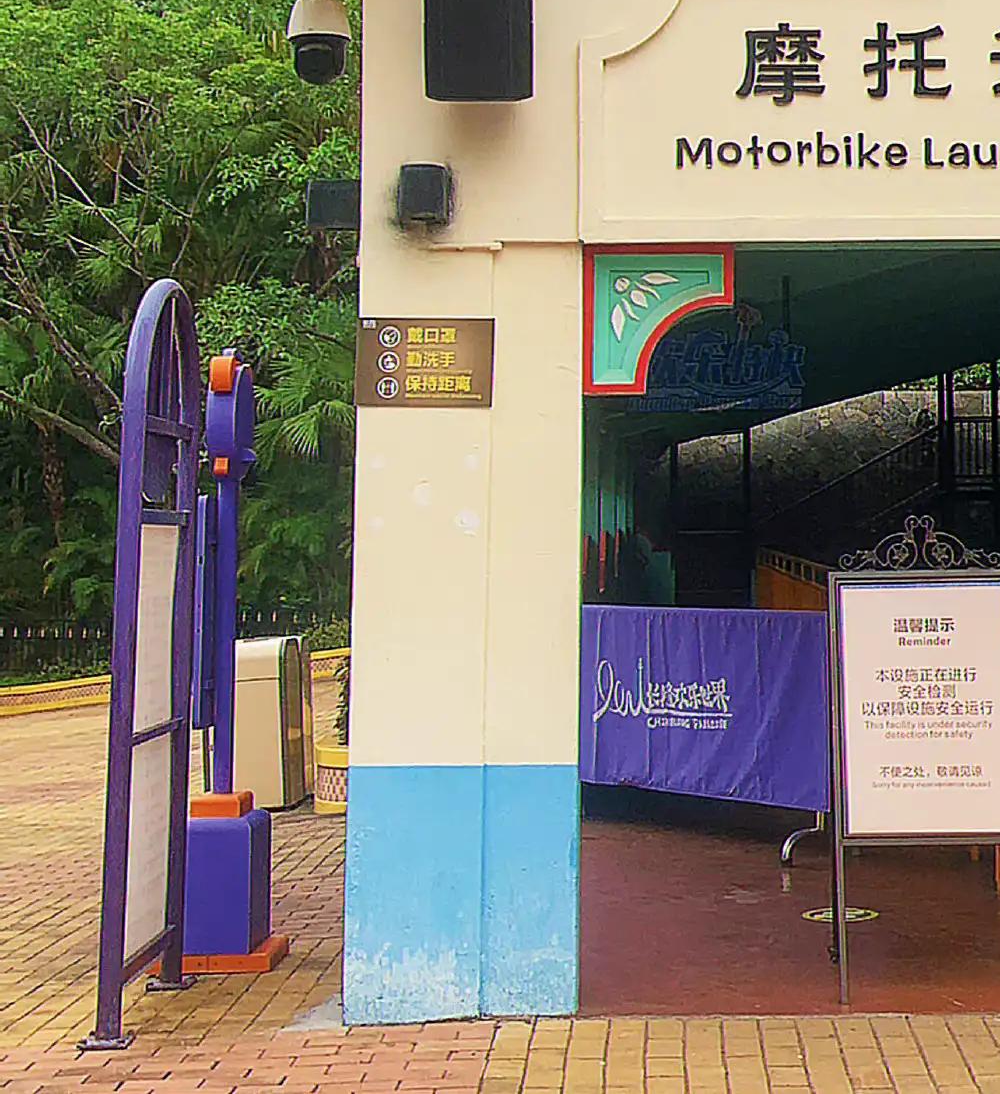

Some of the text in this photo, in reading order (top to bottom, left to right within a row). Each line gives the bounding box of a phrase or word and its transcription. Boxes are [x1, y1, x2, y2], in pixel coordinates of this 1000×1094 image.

[675, 132, 908, 169] Motorbike
[405, 375, 471, 392] 保持距离
[893, 617, 955, 633] 温馨提示
[898, 636, 951, 646] Reminder
[875, 668, 977, 682] 本设施正在进行
[898, 684, 956, 699] 安全检测
[862, 701, 993, 716] 以保障设施安全运行
[927, 720, 954, 729] under
